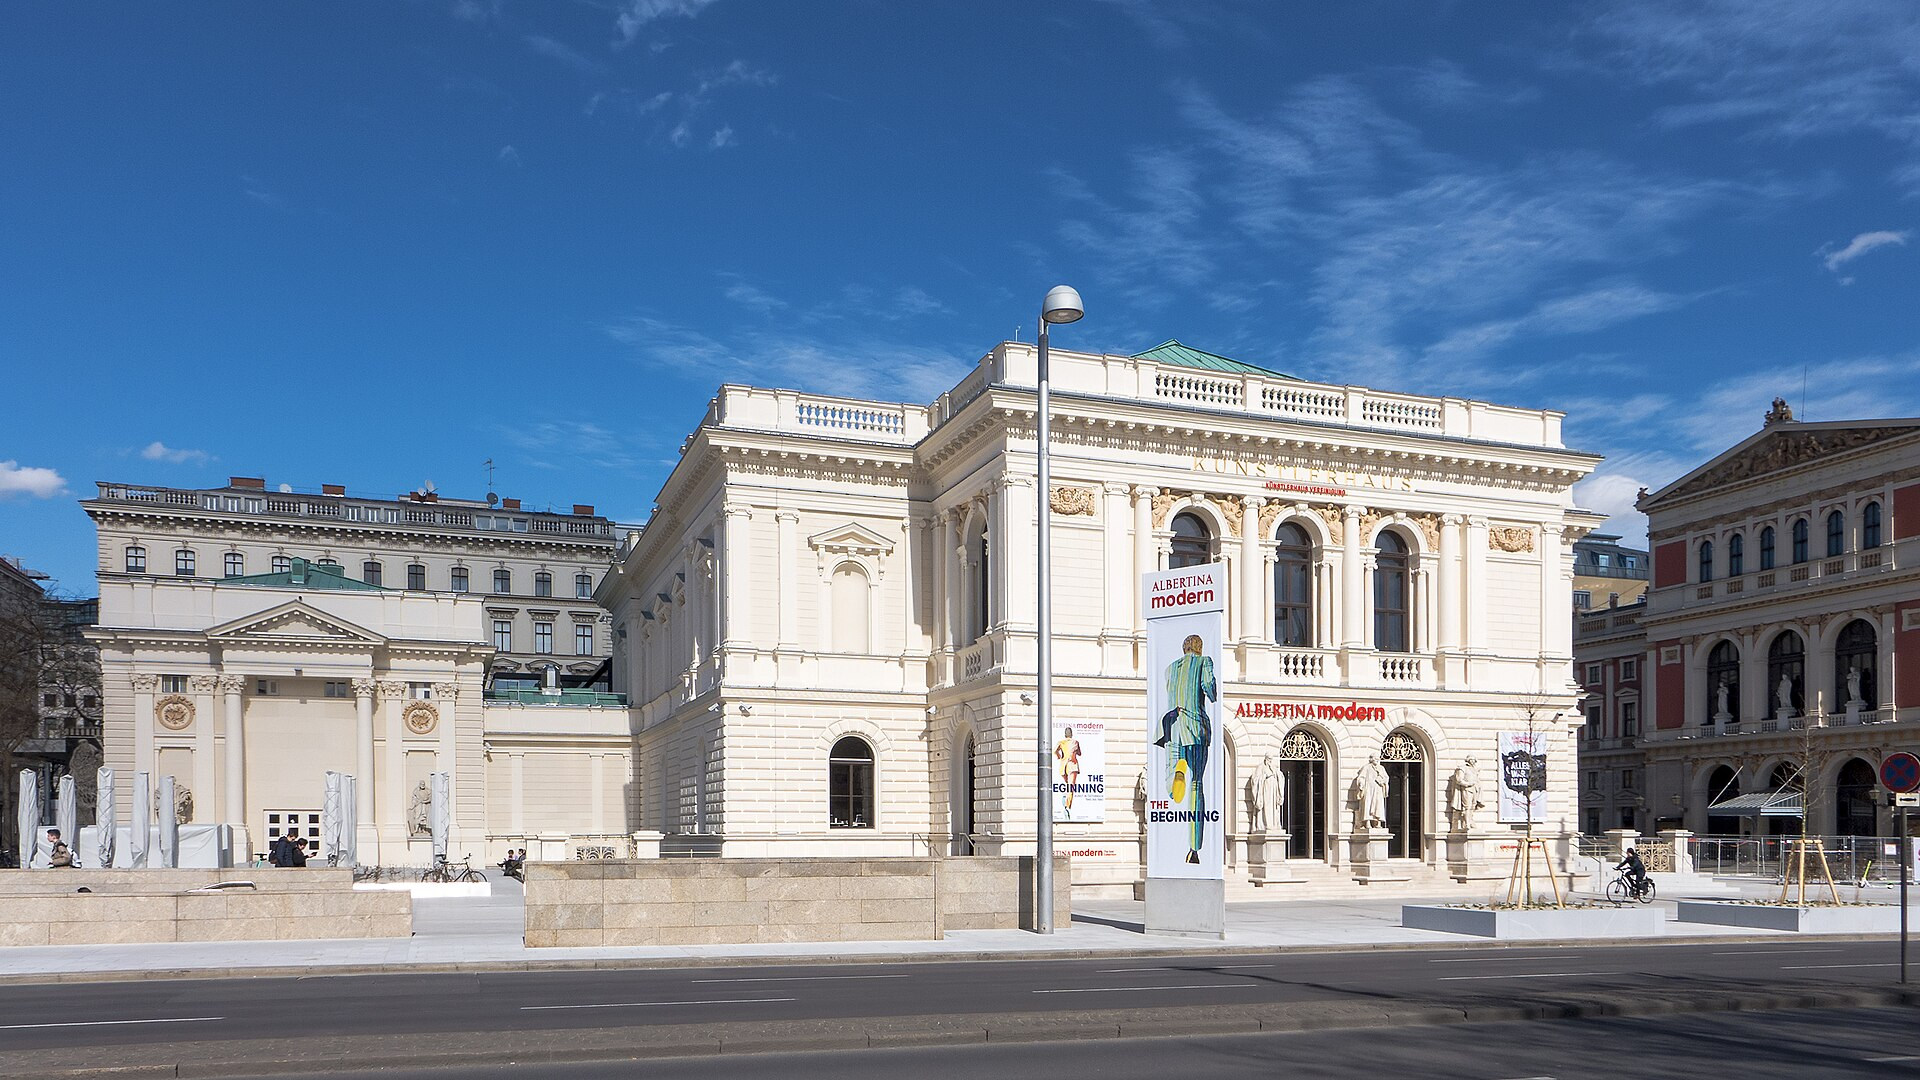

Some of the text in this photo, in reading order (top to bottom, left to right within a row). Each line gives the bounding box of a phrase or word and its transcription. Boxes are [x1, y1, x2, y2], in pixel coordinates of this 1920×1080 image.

[1152, 574, 1213, 592] ALBERTINA
[1151, 589, 1214, 609] modern
[1234, 701, 1385, 721] ALBERTINA modern
[1088, 774, 1103, 782] THE
[1053, 783, 1104, 793] EGINNING
[1150, 800, 1169, 809] THE
[1150, 810, 1220, 822] BEGINNING
[1071, 848, 1103, 857] modern
